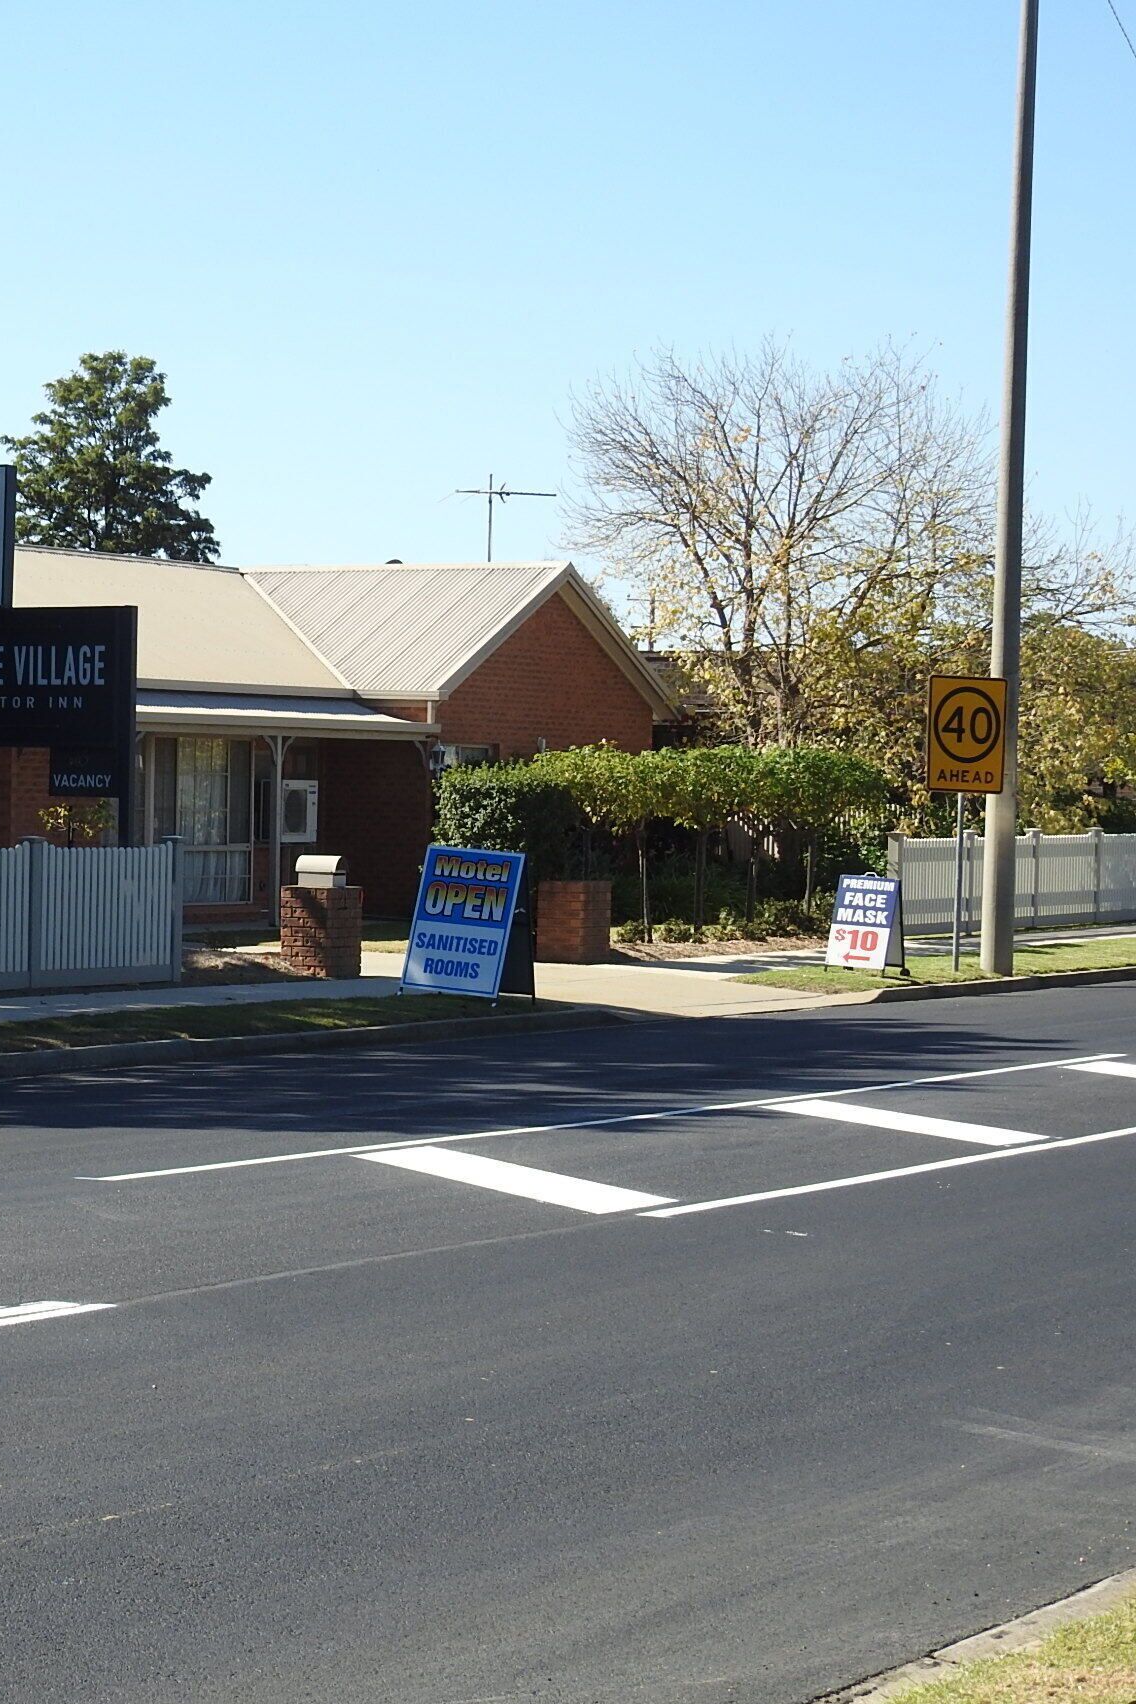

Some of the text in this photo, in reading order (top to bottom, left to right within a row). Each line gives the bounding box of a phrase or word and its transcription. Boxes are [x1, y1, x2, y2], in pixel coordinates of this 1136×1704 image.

[14, 645, 105, 686] VILLAGE
[49, 696, 82, 708] INN
[942, 706, 992, 744] 40
[53, 774, 112, 788] VACANCY
[937, 769, 994, 784] AHEAD
[434, 855, 510, 882] Motel
[842, 878, 895, 892] PREMIUM
[424, 881, 508, 921] OPEN
[844, 892, 887, 908] FACE
[837, 908, 888, 924] MASK
[416, 932, 498, 956] SANITISED
[835, 928, 878, 951] $10
[424, 957, 480, 979] ROOMS
